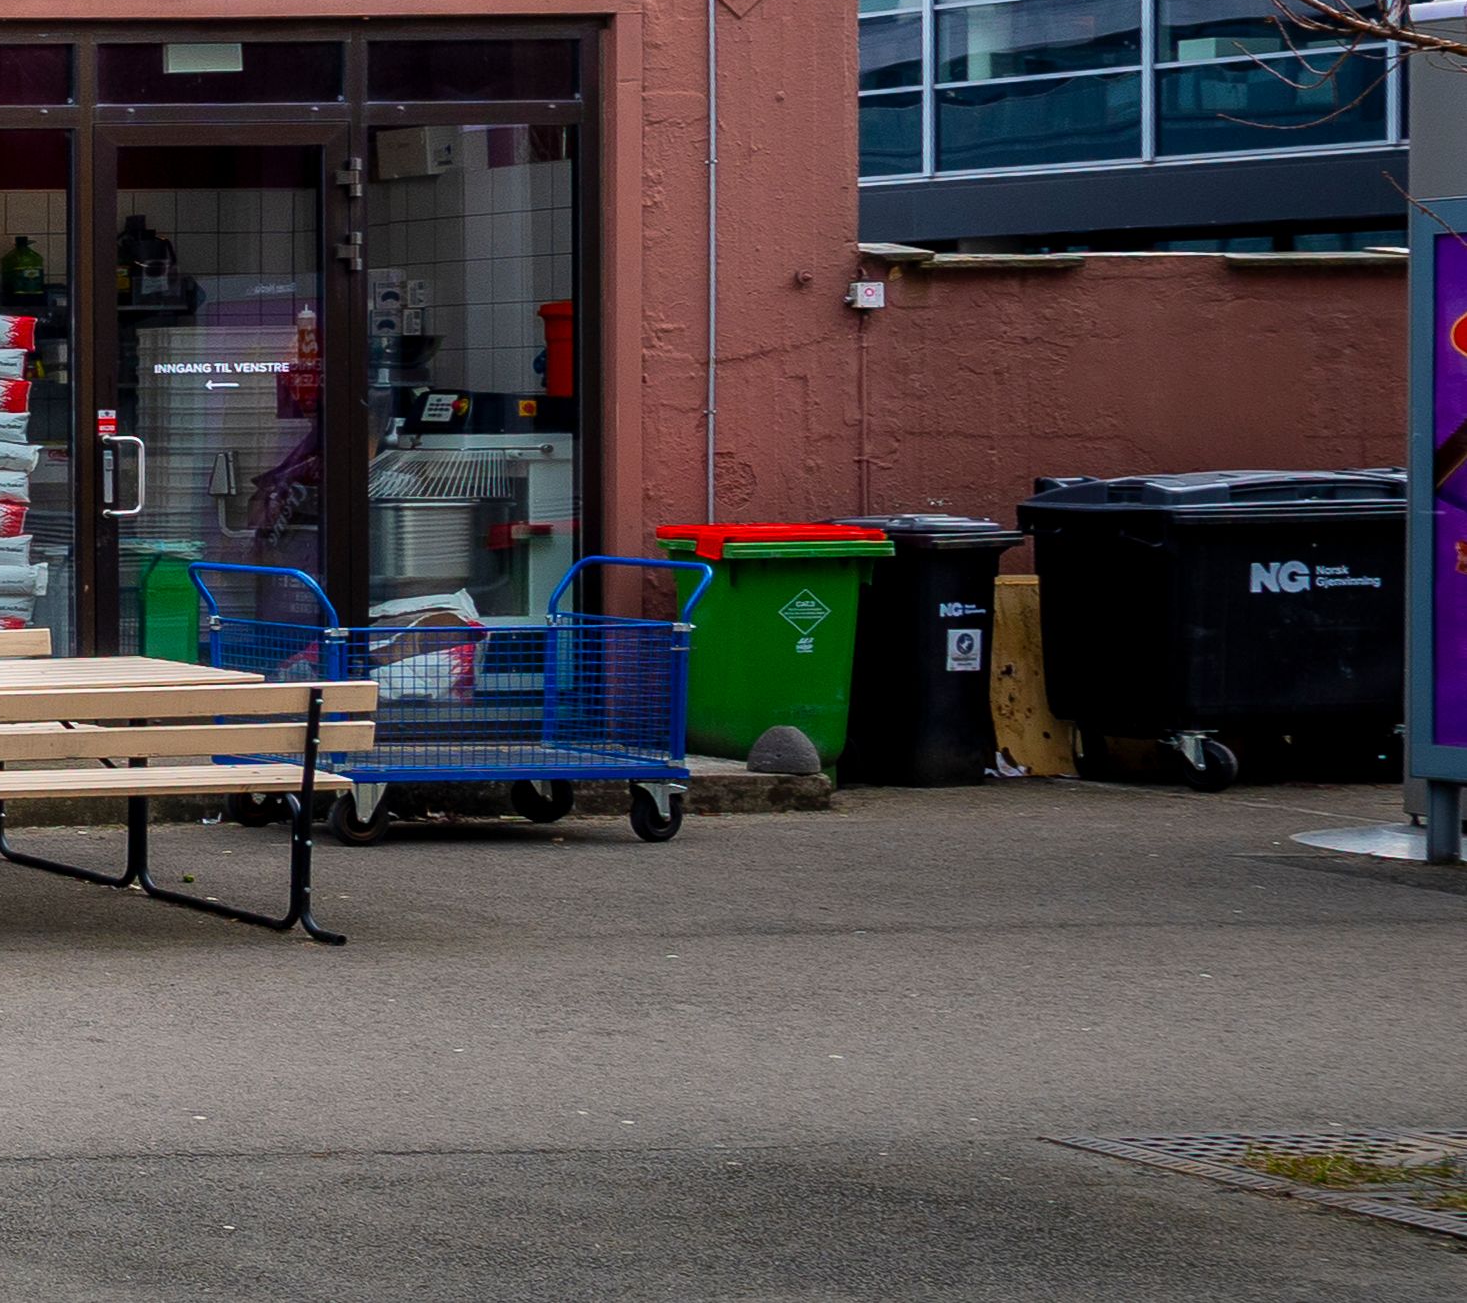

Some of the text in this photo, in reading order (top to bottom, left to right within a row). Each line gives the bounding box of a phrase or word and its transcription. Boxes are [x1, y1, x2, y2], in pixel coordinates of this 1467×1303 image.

[154, 363, 212, 374] INNGANG
[214, 363, 232, 373] TIL
[234, 362, 290, 373] VENSTRE
[1250, 560, 1311, 593] NG
[1315, 565, 1349, 575] Norsk
[939, 602, 964, 617] NG
